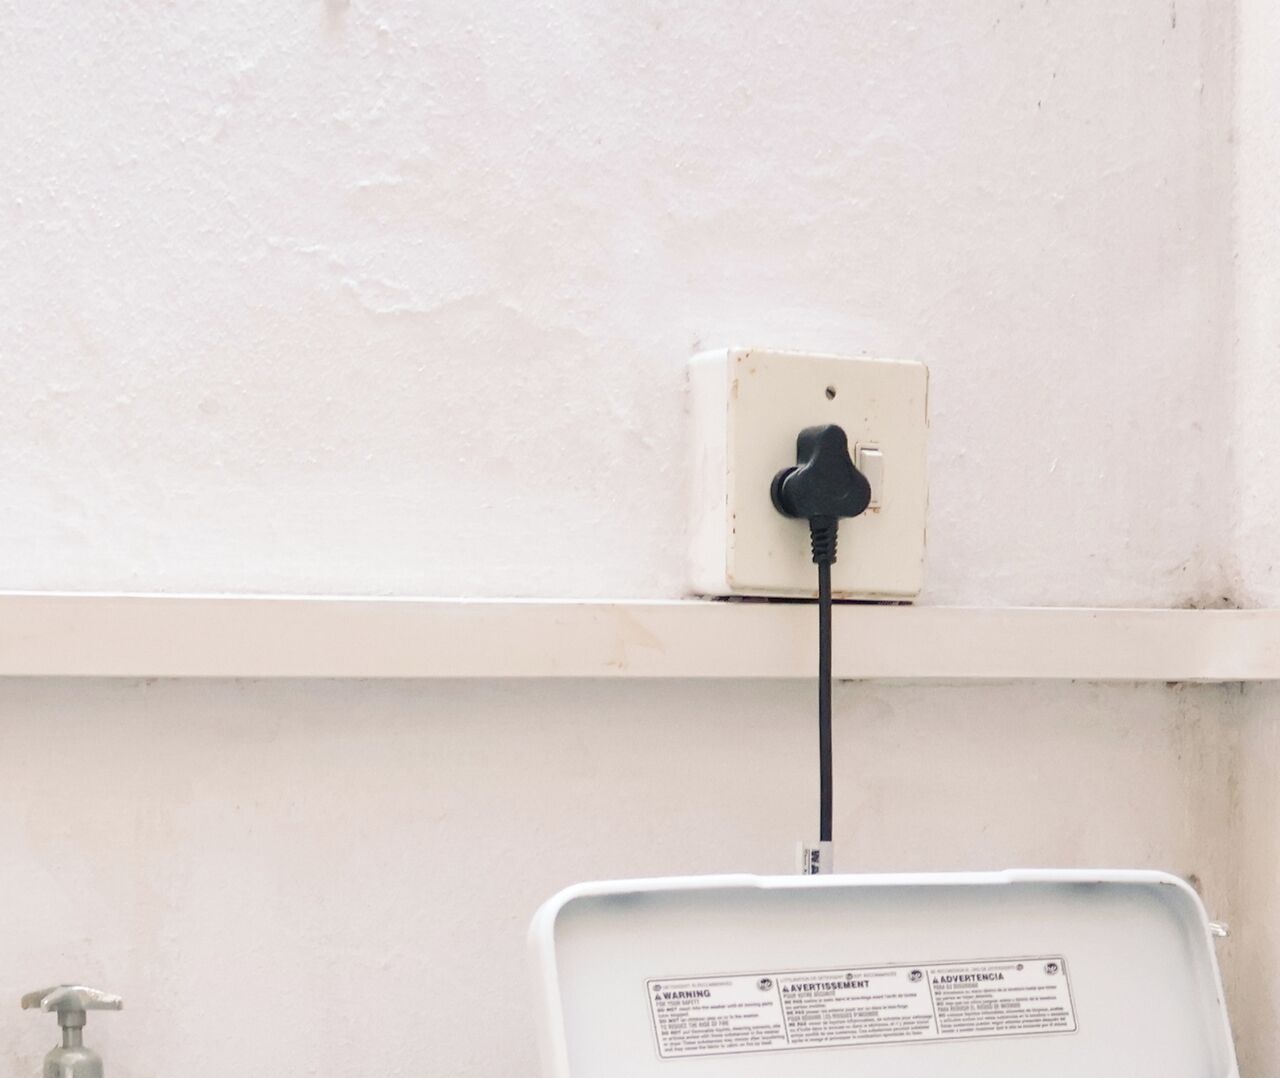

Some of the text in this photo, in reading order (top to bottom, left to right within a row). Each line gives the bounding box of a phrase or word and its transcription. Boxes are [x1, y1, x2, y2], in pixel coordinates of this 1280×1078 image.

[940, 972, 1004, 984] ADVERTENCIA
[791, 980, 869, 992] AVERTISSEMENT
[663, 990, 711, 1000] WARNING
